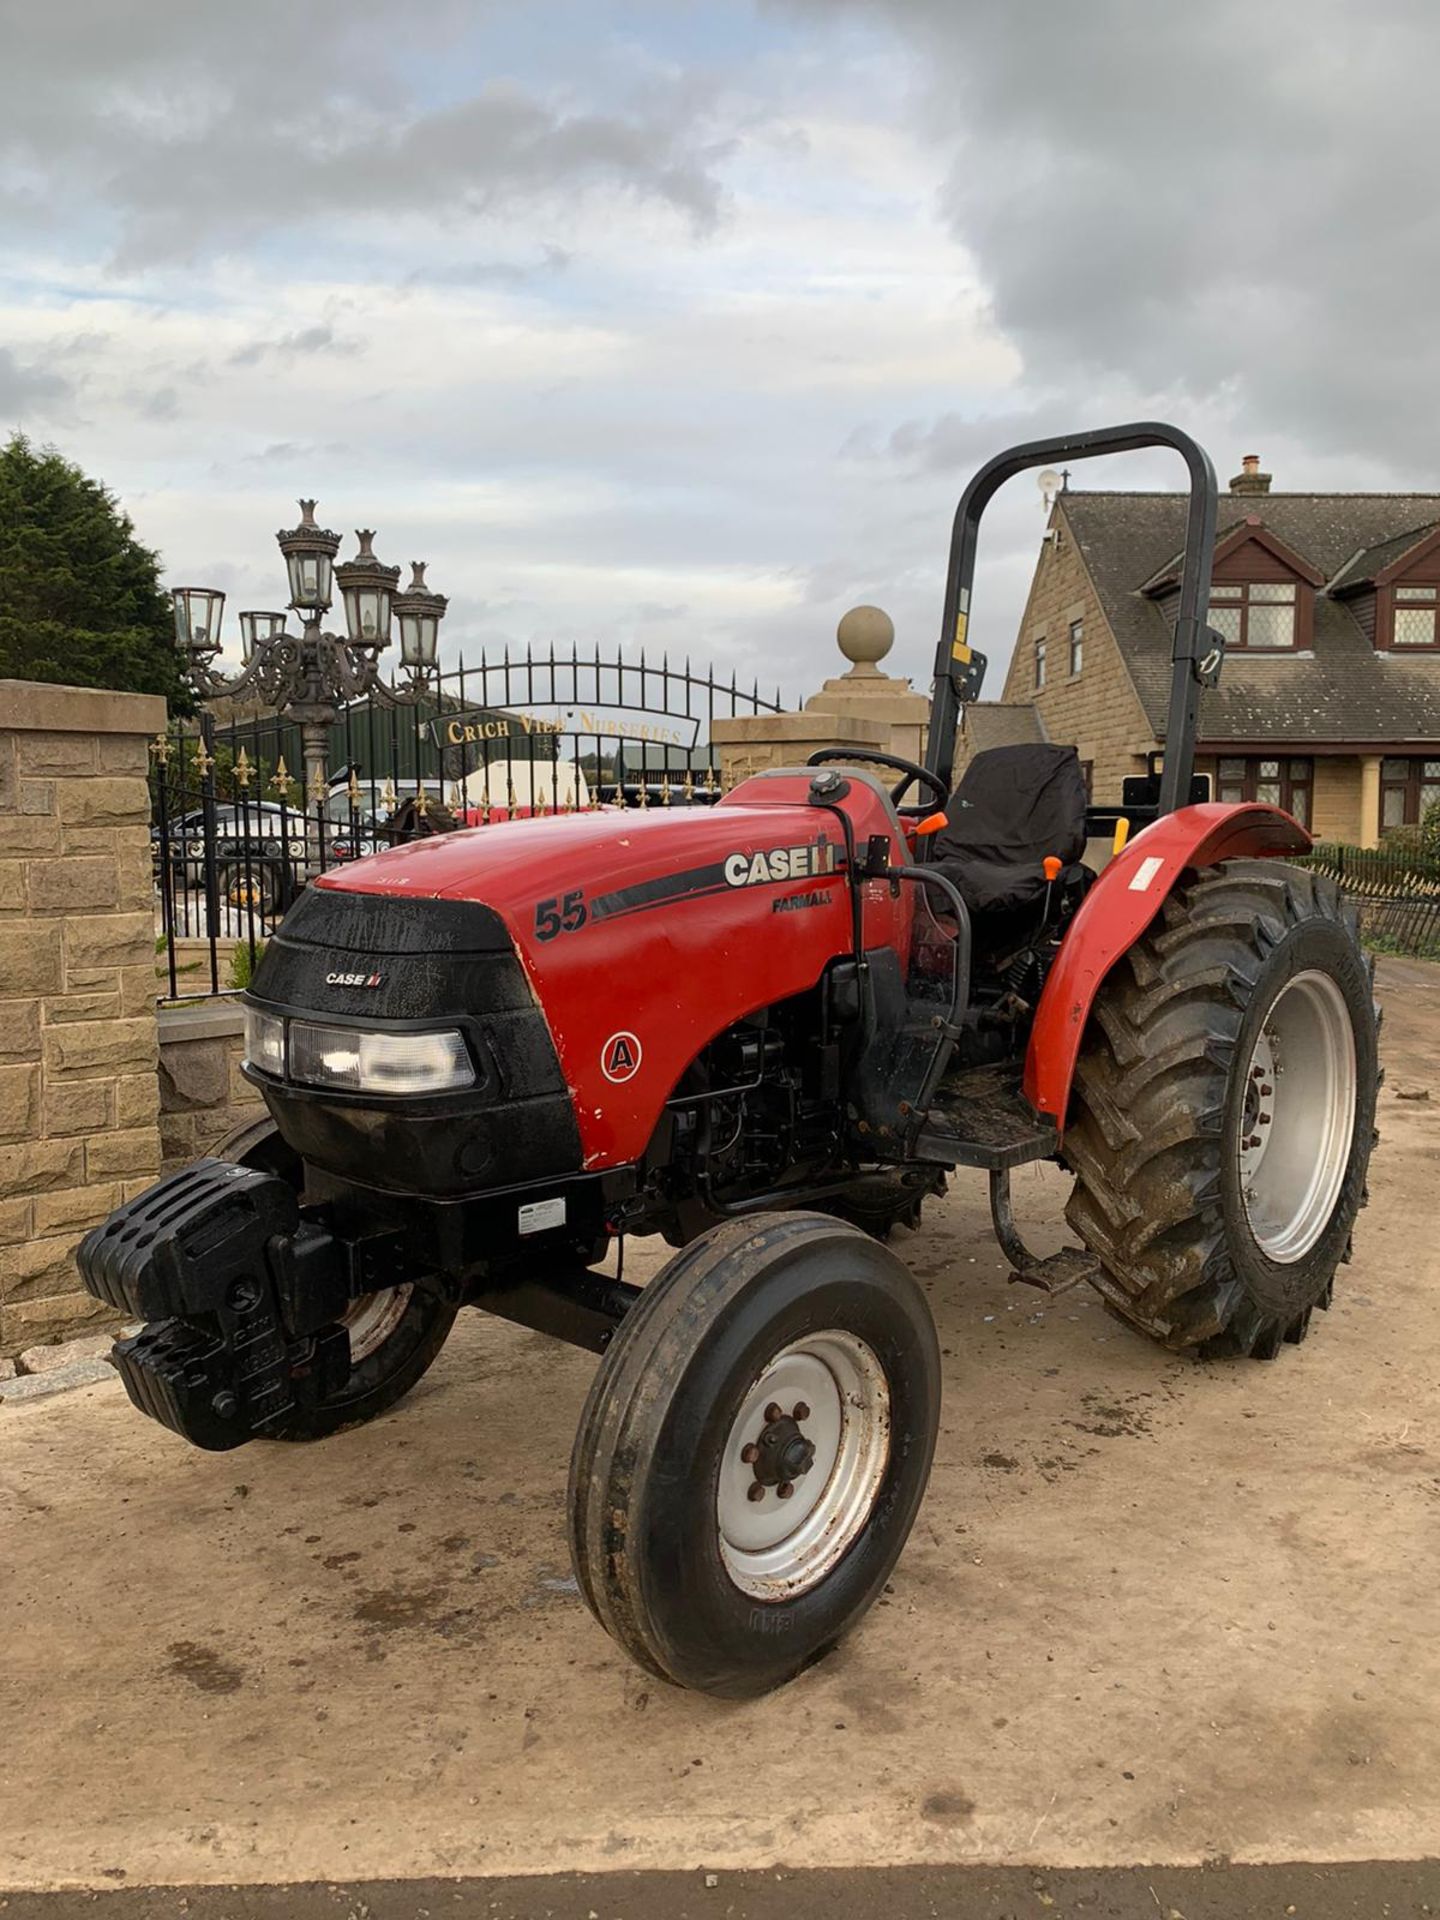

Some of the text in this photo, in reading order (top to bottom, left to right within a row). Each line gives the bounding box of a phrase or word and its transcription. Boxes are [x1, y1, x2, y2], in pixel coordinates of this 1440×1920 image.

[772, 889, 832, 912] FARMALL
[535, 890, 587, 943] 55
[326, 972, 366, 986] CASE
[609, 1037, 635, 1073] A
